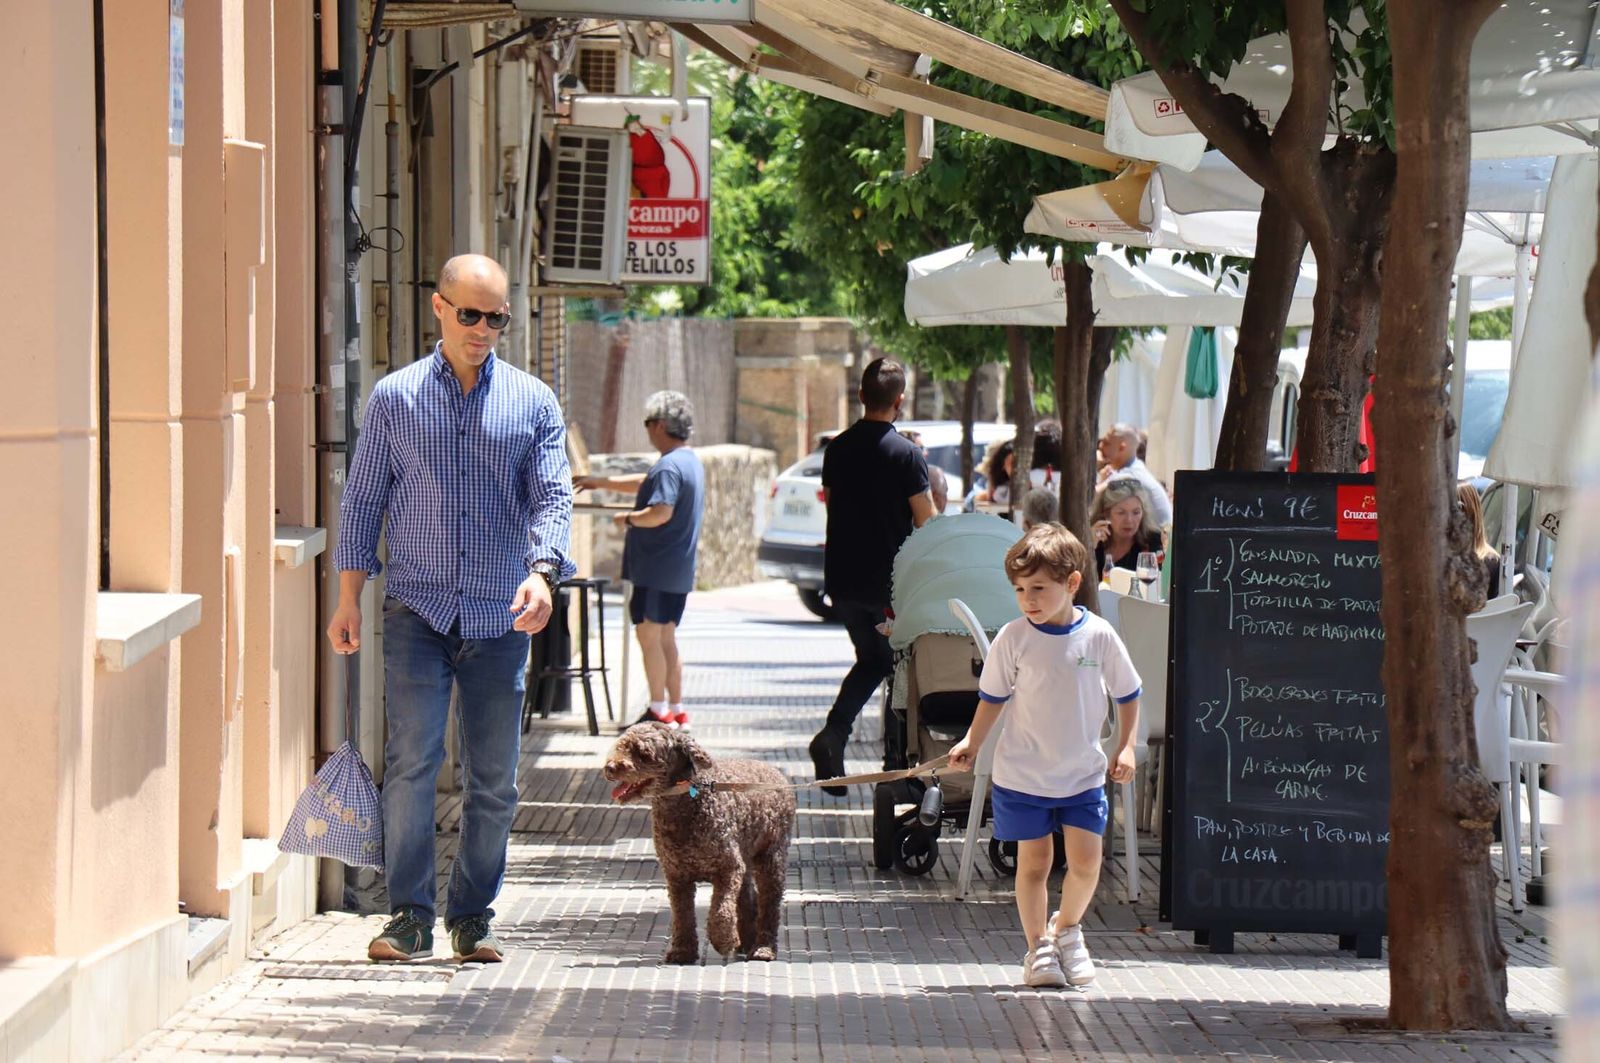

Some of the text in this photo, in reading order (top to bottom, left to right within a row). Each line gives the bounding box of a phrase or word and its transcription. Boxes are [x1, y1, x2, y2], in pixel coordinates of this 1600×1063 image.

[629, 206, 700, 229] campo
[646, 241, 677, 257] LOS
[1240, 538, 1320, 566] ENSALADA
[1233, 590, 1313, 610] TORTILLA
[1317, 598, 1336, 610] DE
[1236, 614, 1294, 636] POTAJE
[1302, 625, 1318, 638] DE
[1313, 722, 1382, 743] FRITAS
[1344, 764, 1368, 783] DE
[1313, 820, 1372, 845] BEBIDA
[1221, 846, 1238, 864] LA
